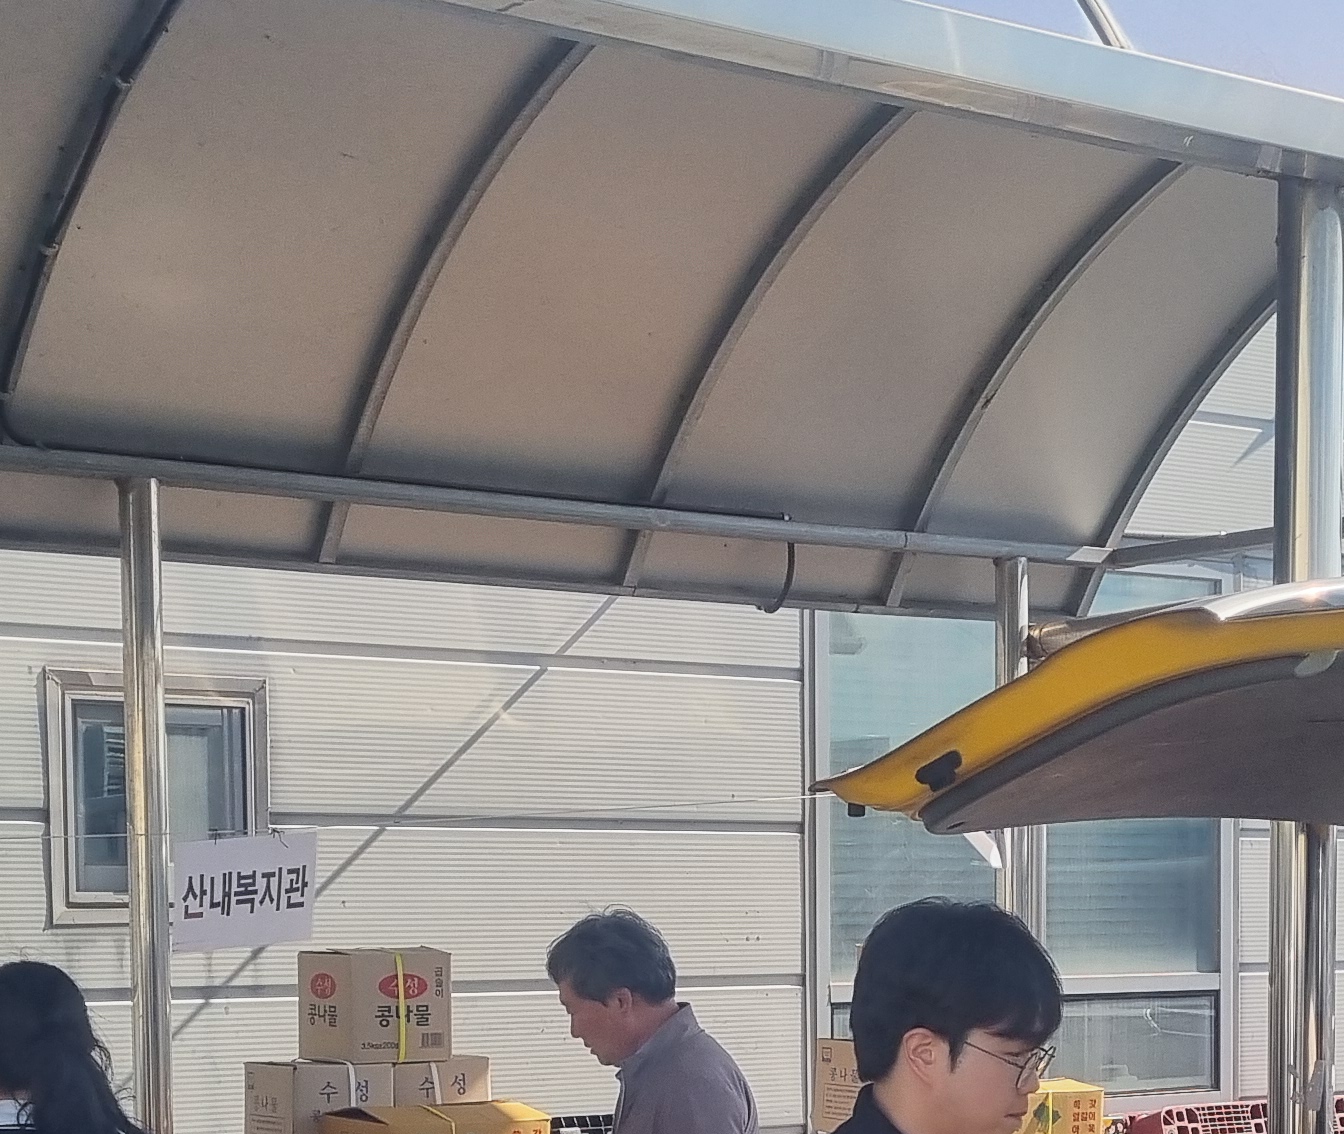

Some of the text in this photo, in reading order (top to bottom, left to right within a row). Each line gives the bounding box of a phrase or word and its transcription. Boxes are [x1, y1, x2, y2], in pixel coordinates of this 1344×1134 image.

[181, 864, 308, 921] 산내복지관
[307, 1003, 338, 1028] 콩나물
[374, 1003, 432, 1028] 콩나물
